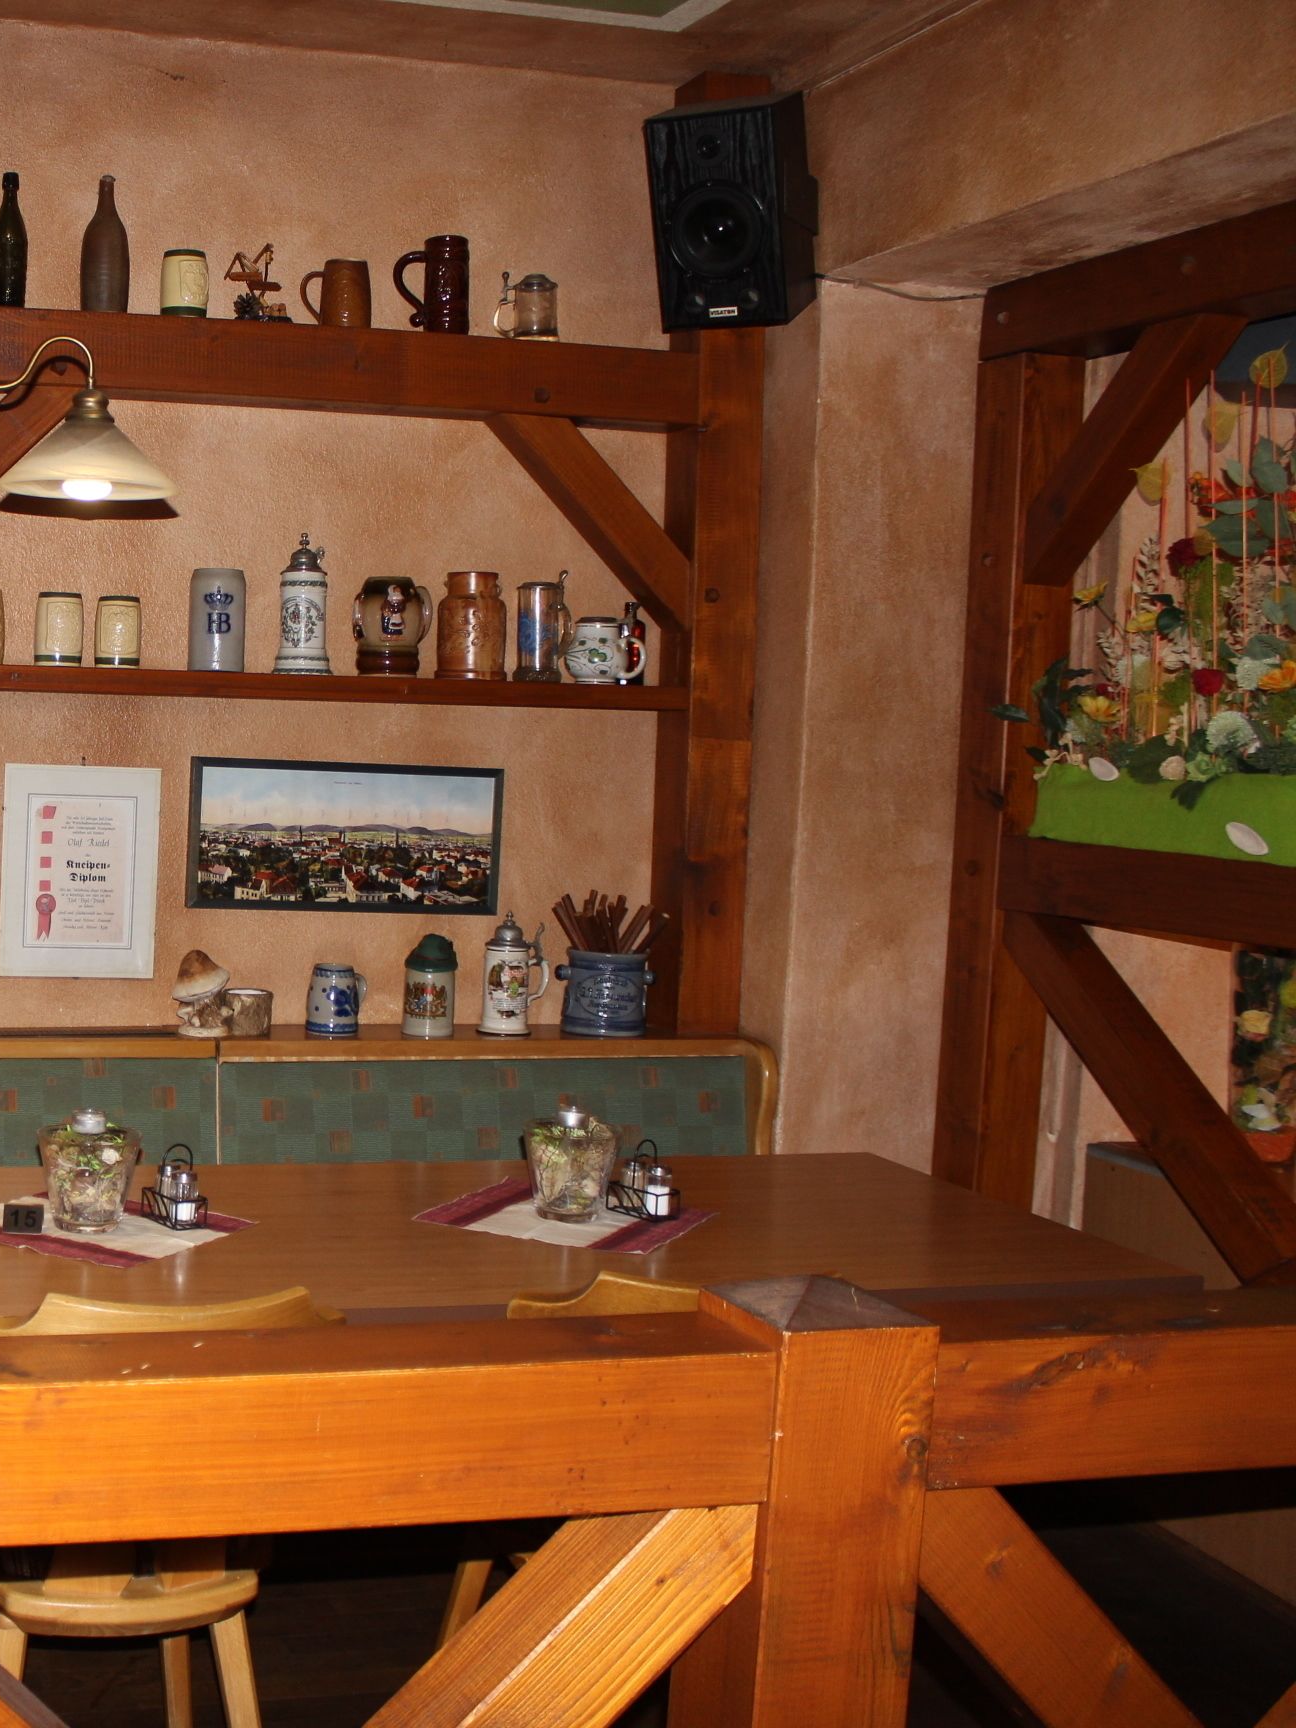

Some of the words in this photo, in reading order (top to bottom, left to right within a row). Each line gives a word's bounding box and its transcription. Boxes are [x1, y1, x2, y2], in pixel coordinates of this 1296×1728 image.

[207, 612, 232, 635] HB
[69, 872, 106, 884] Diplom
[10, 1209, 36, 1228] 15
